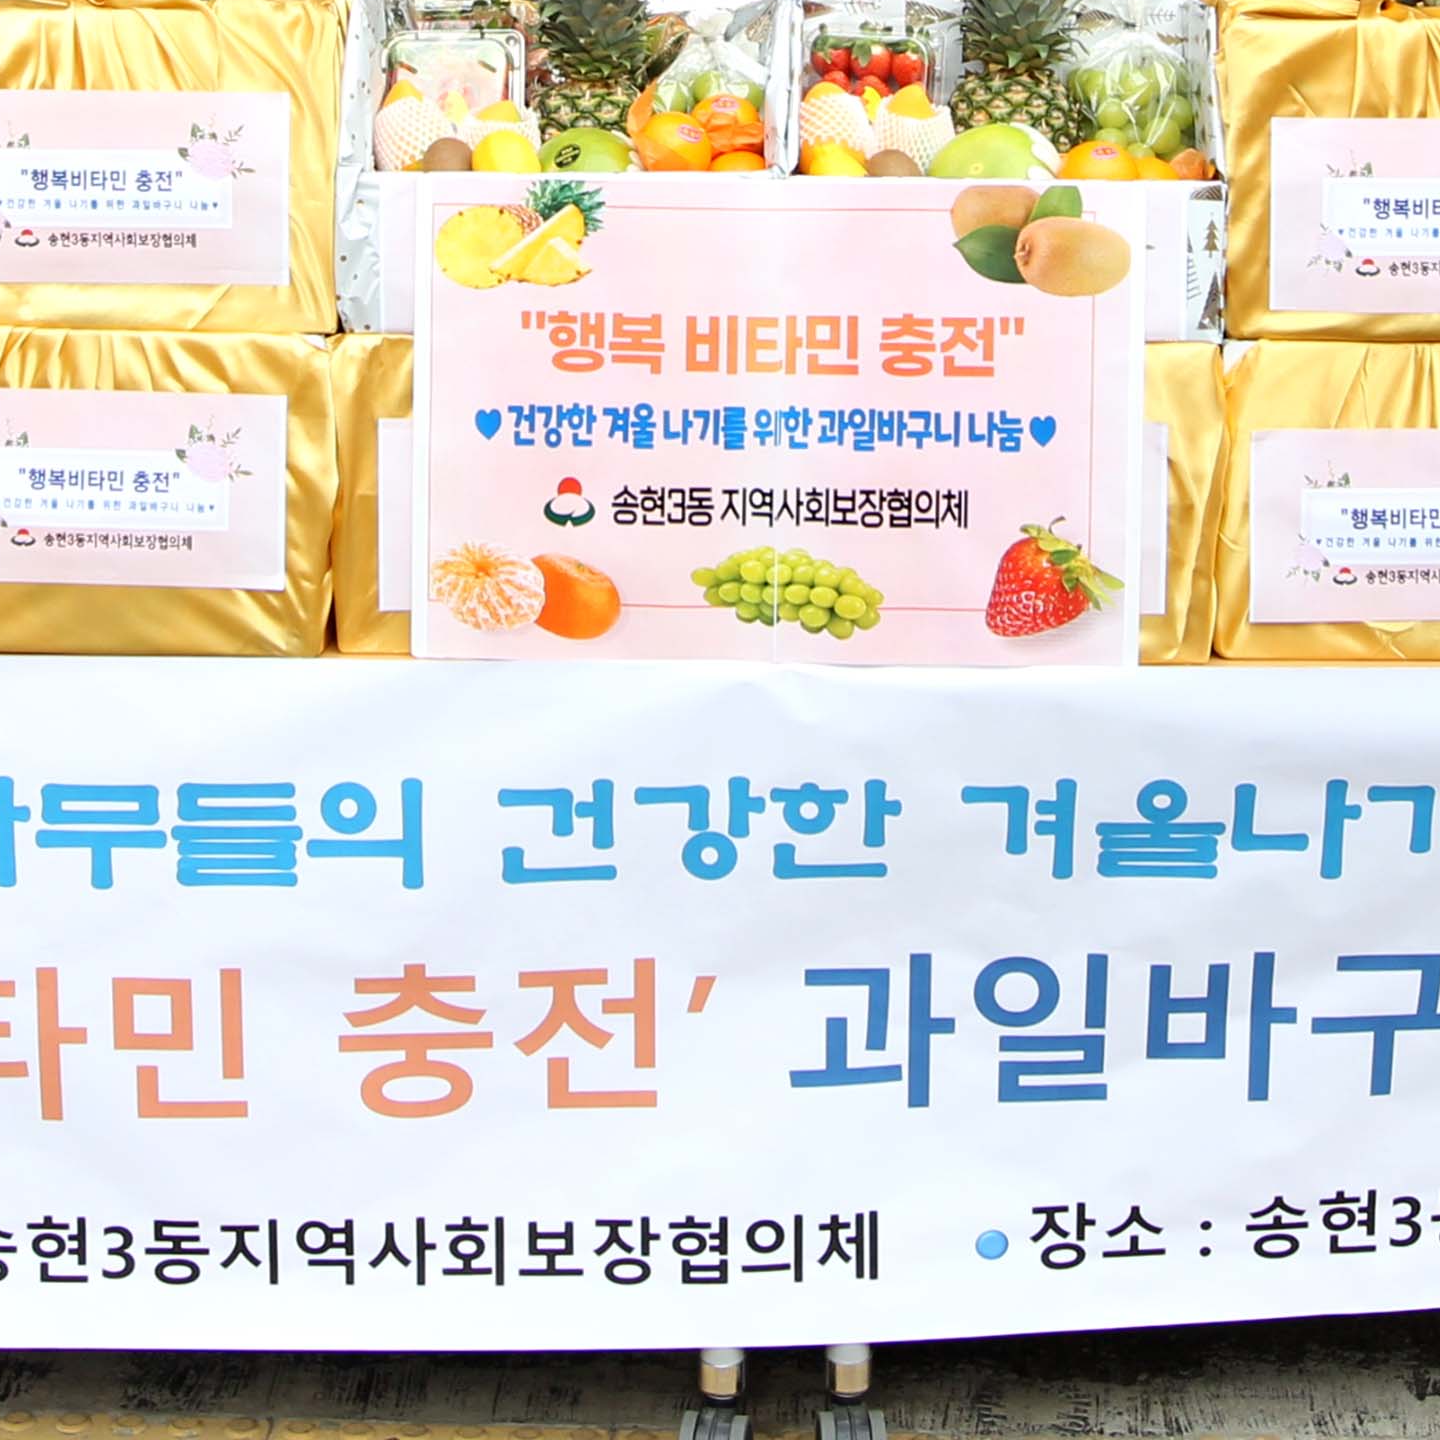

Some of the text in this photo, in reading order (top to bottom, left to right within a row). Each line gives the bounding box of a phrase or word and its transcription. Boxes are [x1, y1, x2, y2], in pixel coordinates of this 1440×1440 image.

[135, 170, 183, 193] 충전"
[48, 233, 197, 248] 송현3동지역사회보장협의체
[522, 311, 1024, 377] "행복 비타민 충전"
[508, 404, 1024, 451] 건강한 겨울 나기를 위한 과일바구니 나눔
[132, 471, 180, 495] 충전"
[611, 486, 970, 530] 송현3동 지역사회보장협의체
[44, 533, 193, 550] 송현3동지역사회보장협의체
[498, 776, 902, 884] 건강한
[1030, 1202, 1166, 1270] 장소
